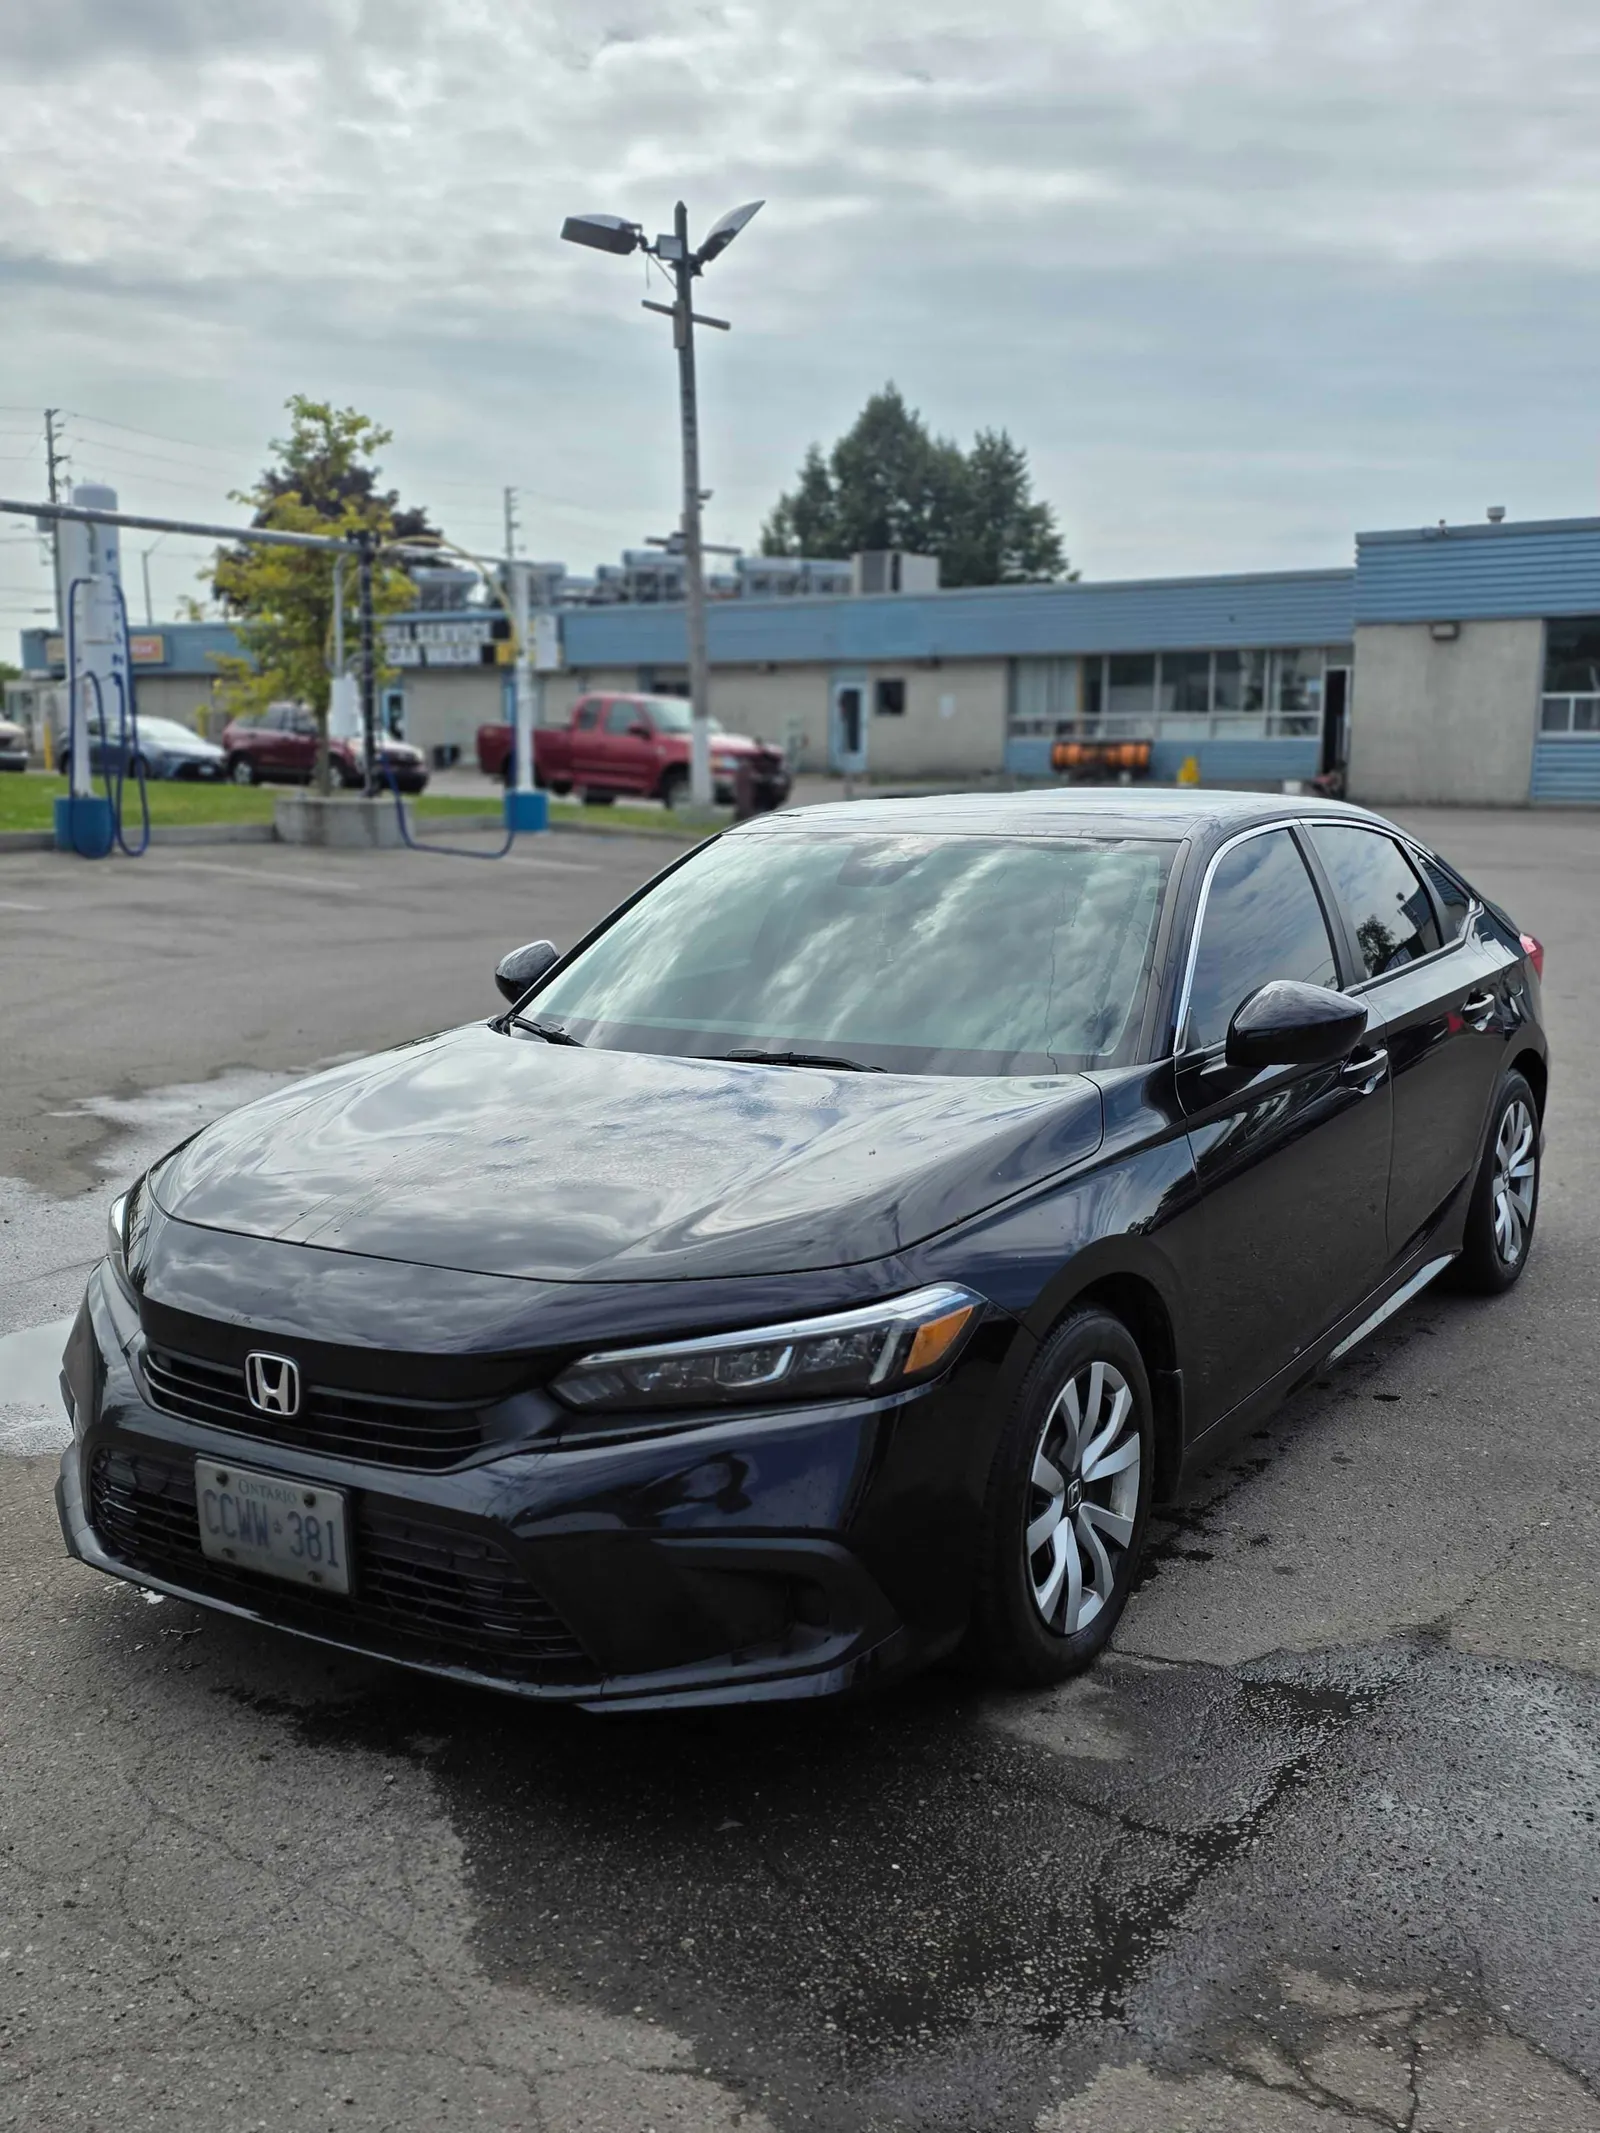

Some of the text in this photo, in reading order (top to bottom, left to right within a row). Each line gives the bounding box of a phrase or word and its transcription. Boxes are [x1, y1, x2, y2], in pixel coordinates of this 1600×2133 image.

[238, 1479, 299, 1505] ONTARIO
[203, 1488, 339, 1568] CCWW 381
